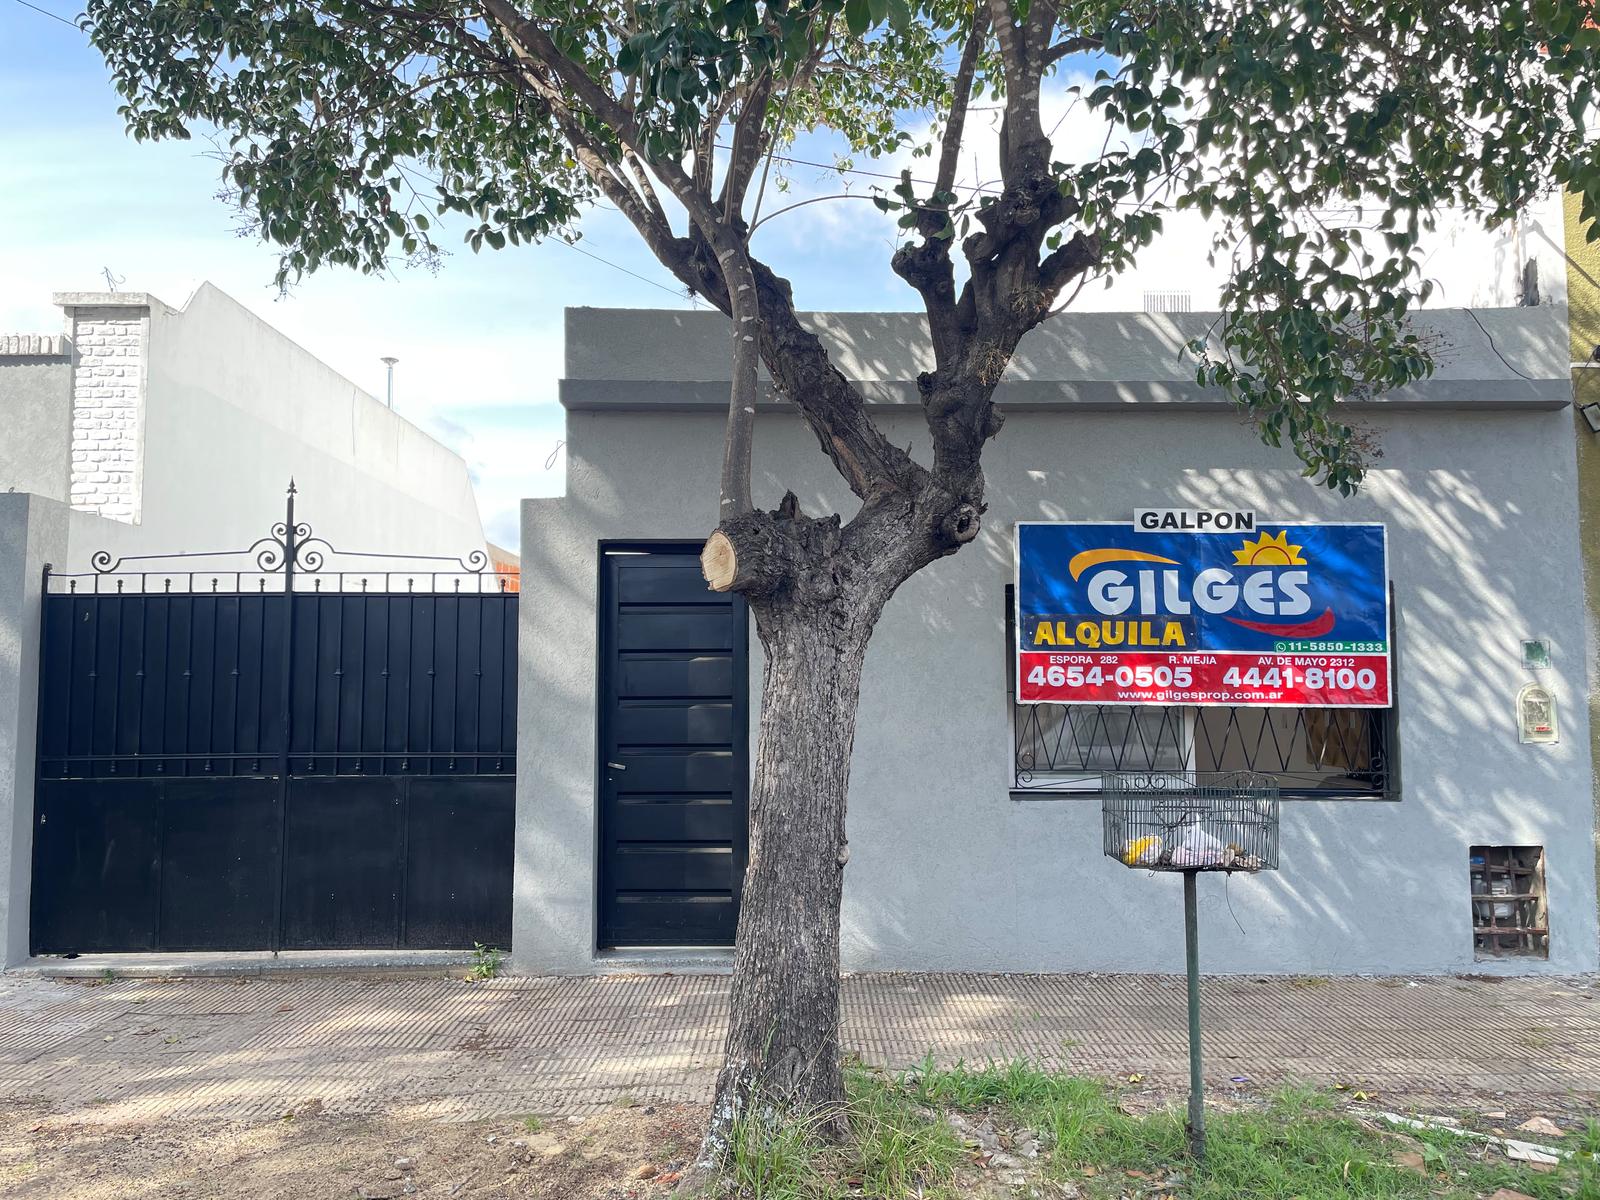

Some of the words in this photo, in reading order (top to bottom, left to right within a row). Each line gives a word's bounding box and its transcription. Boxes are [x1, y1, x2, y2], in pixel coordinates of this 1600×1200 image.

[1140, 511, 1253, 530] GALPON
[1087, 567, 1312, 616] GILGES
[1033, 621, 1187, 649] ALQUILA
[1288, 642, 1384, 652] 11-5850-1333
[1050, 656, 1093, 665] ESPORA
[1100, 656, 1118, 665] 282
[1168, 656, 1180, 665] R.
[1183, 656, 1217, 665] MEJIA
[1257, 656, 1274, 666] AV.
[1277, 657, 1292, 666] DE
[1295, 657, 1327, 666] MAYO
[1330, 658, 1355, 667] 2312
[1027, 666, 1193, 688] 4654-0505
[1222, 666, 1377, 690] 4441-8100
[1117, 689, 1284, 701] www.gilgesprop.com.ar
